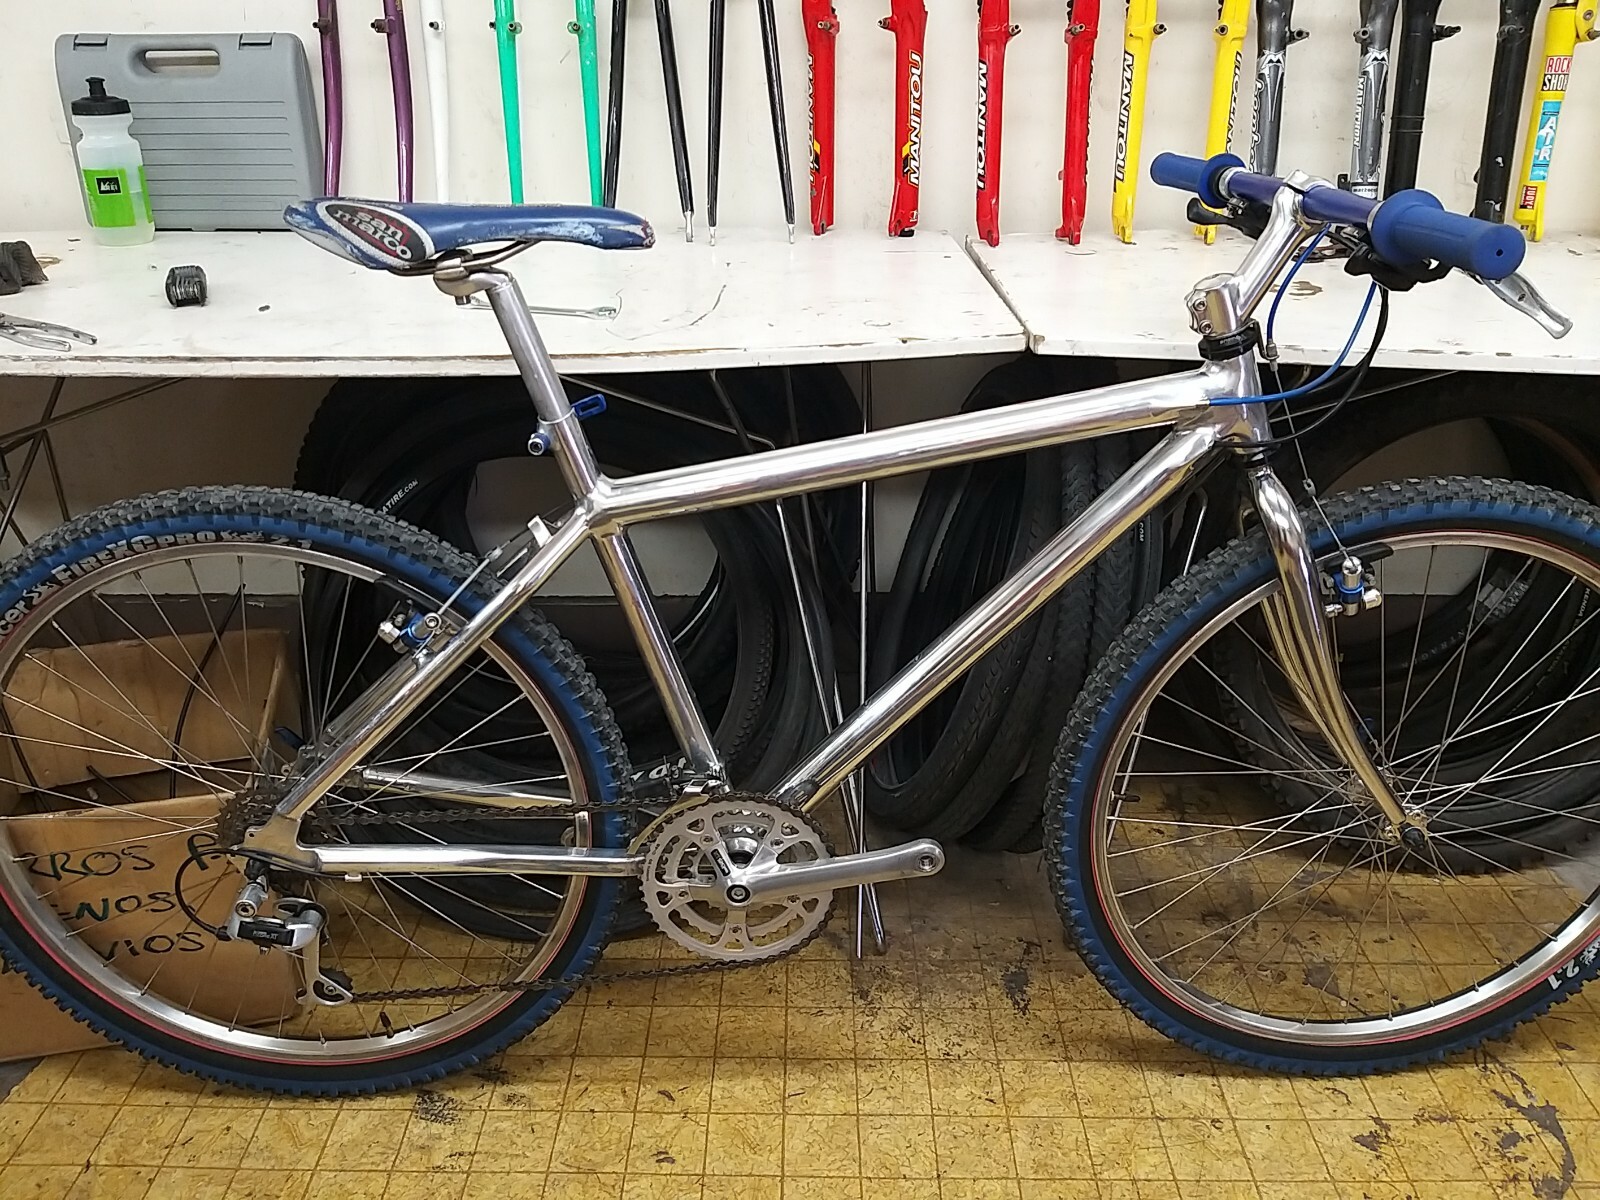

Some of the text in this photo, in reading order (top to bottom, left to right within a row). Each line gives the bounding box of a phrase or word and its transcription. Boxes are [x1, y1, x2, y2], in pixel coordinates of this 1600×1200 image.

[908, 51, 923, 187] MANITOU
[975, 59, 987, 191] MANITOU
[1115, 51, 1134, 183] MANITOU
[1353, 76, 1367, 150] MARATHON
[333, 208, 413, 261] marco
[355, 211, 403, 242] san
[1548, 958, 1580, 990] 2.1
